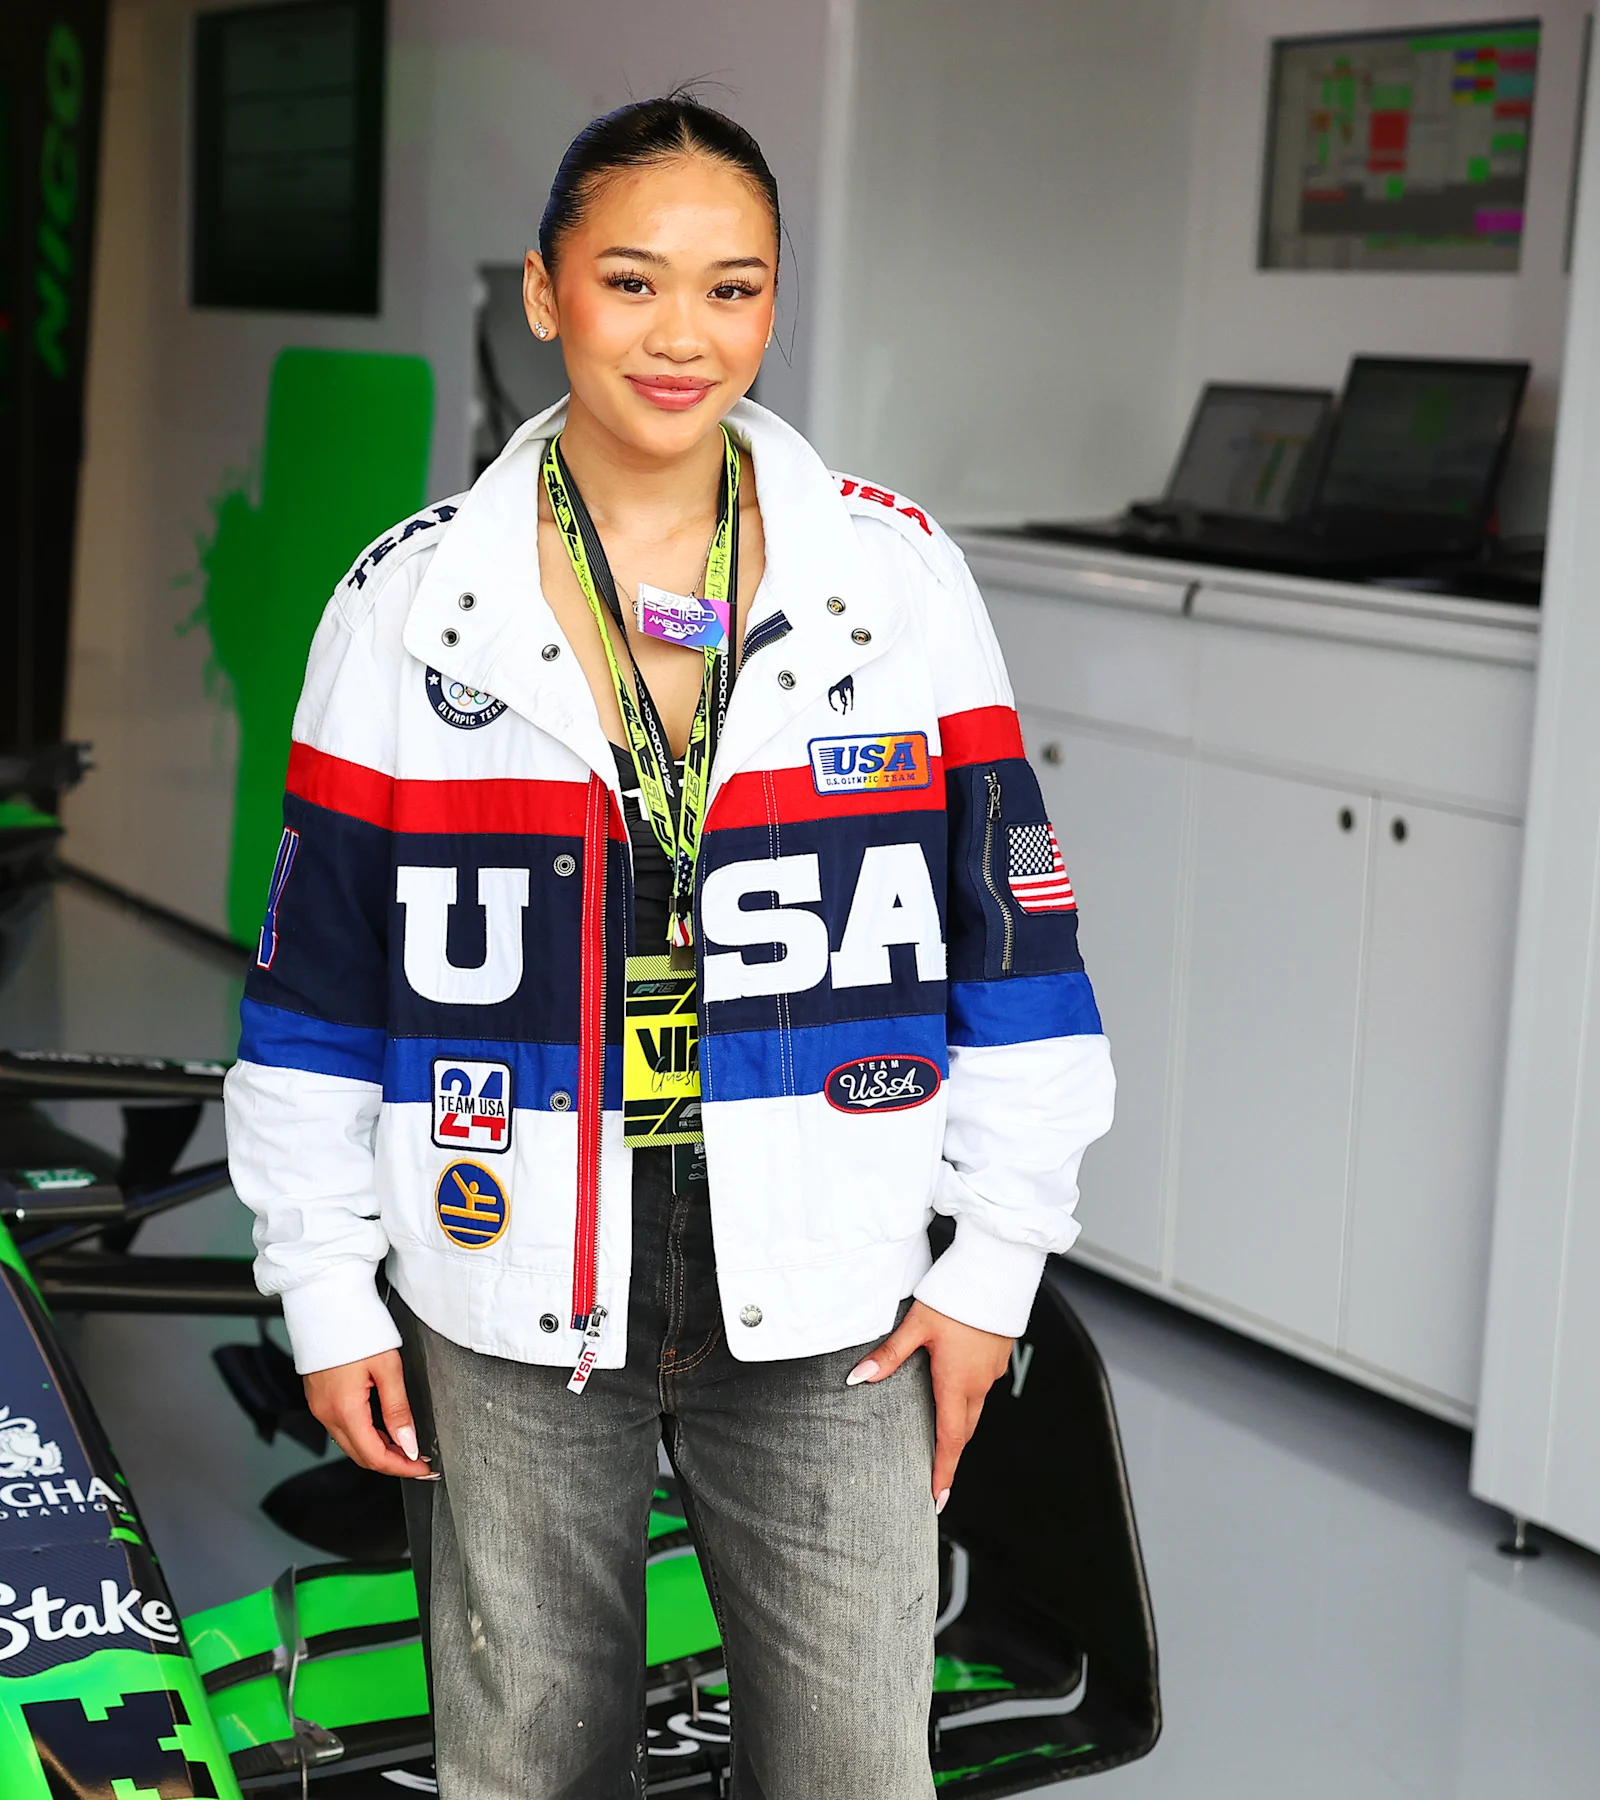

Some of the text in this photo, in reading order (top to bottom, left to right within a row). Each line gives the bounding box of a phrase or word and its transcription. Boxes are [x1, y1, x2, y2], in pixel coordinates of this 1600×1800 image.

[34, 21, 84, 380] NICO
[437, 701, 476, 725] OLYMPIC
[629, 722, 646, 751] VIP
[642, 700, 670, 774] PADDOCK
[690, 715, 705, 745] VIP
[831, 742, 916, 776] USA
[884, 772, 916, 782] TEAM
[858, 1059, 900, 1072] TEAM
[839, 1067, 924, 1100] USA
[439, 1068, 506, 1142] 24
[439, 1095, 505, 1117] TEAM USA
[573, 1351, 596, 1382] USA
